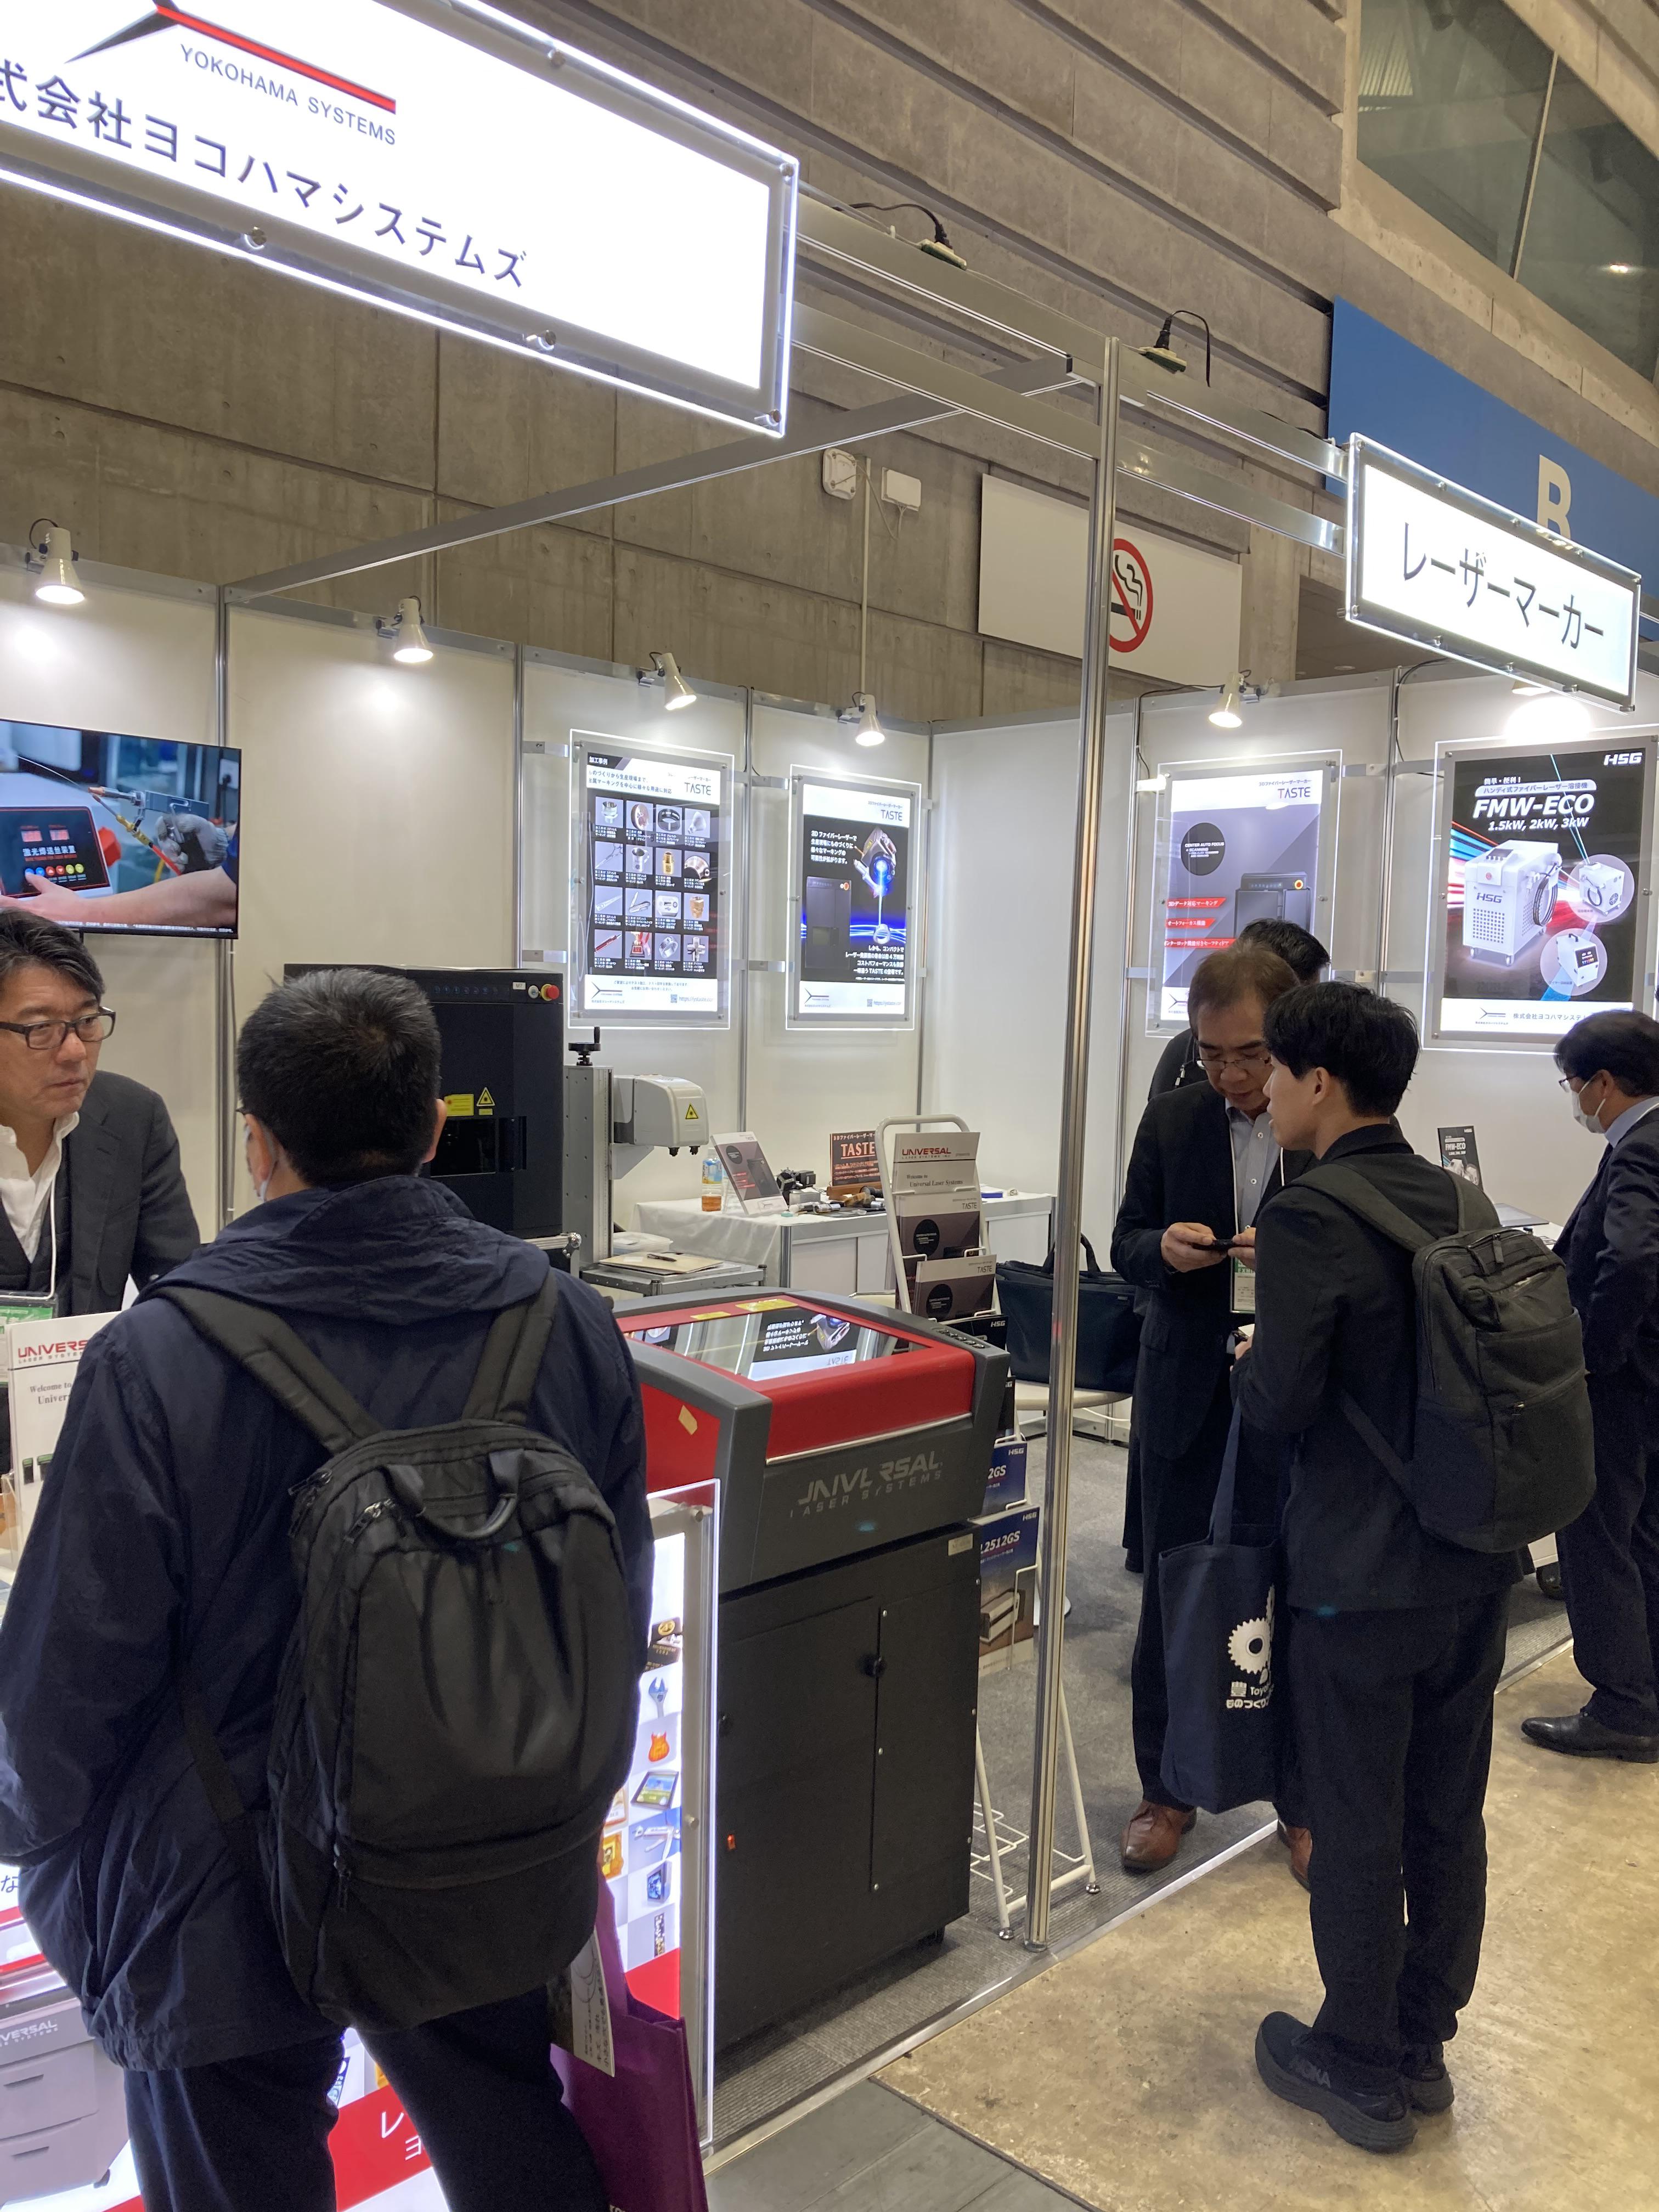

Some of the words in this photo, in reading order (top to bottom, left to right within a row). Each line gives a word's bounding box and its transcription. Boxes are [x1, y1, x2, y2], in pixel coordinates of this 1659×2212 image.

[180, 43, 299, 106] YOKOHAMA
[307, 97, 396, 145] SYSTEMS
[0, 59, 527, 287] 式会社ヨコハマシステムズ
[1403, 522, 1604, 649] レーザーマーカー
[1604, 752, 1643, 765] HSG
[684, 782, 711, 795] TASTE
[1277, 787, 1311, 799] TASTE
[1483, 782, 1588, 793] ハンディ式ファイバーレーザー溶接機
[1472, 793, 1594, 819] FMW-ECO
[881, 810, 903, 821] TASTE
[1488, 819, 1527, 831] 1.5kW,
[1529, 819, 1559, 830] 2kW,
[1561, 817, 1589, 828] 3kW
[1476, 893, 1503, 903] HSG
[840, 1142, 875, 1157] TASTE
[18, 1340, 88, 1358] UNIVERS
[30, 1384, 62, 1393] Welcome
[38, 1394, 70, 1404] Univer
[988, 1465, 1007, 1480] 2GS
[1023, 1512, 1037, 1521] HSG
